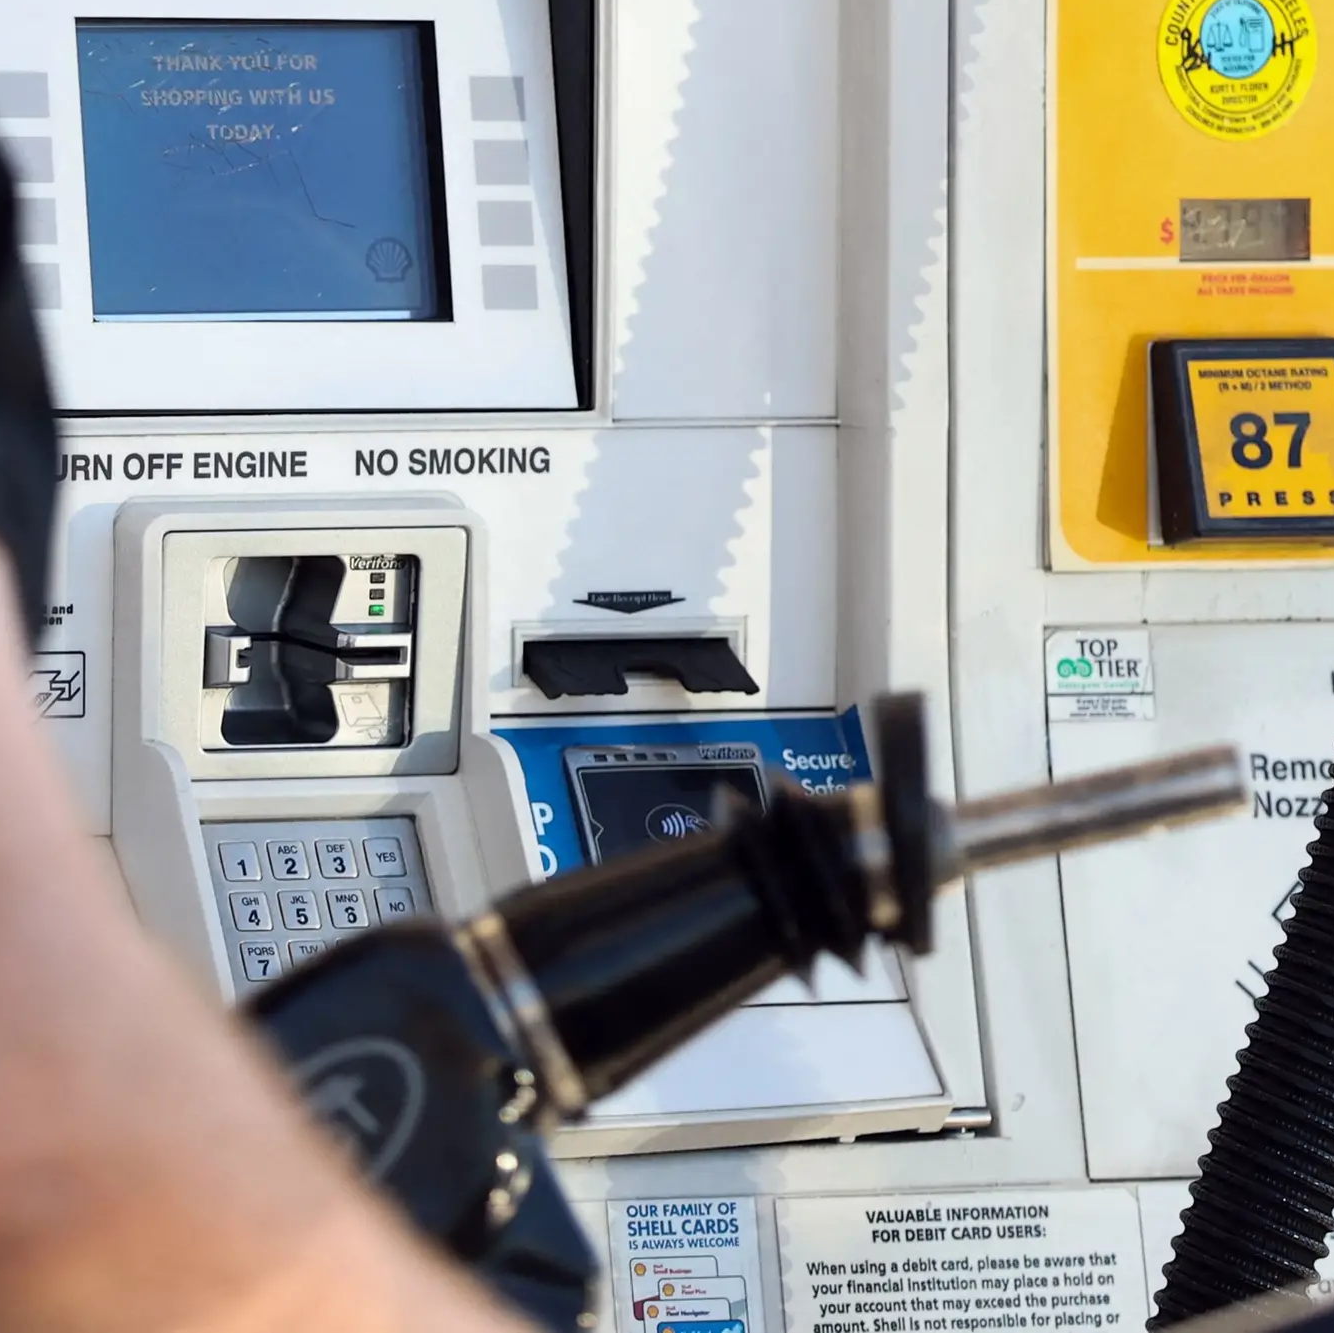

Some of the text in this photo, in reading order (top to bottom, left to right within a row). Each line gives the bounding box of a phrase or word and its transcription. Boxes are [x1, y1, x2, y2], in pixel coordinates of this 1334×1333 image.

[153, 54, 223, 72] THANK
[228, 54, 270, 72] YOU
[141, 89, 336, 107] SHOPPING WITH US
[1160, 217, 1175, 246] $
[1246, 369, 1288, 379] OCTANE
[1268, 381, 1312, 391] METHOD
[1229, 411, 1312, 469] 87
[56, 447, 551, 482] URN OFF ENGINE NO SMOKING
[1075, 638, 1119, 658] TOP
[1253, 790, 1324, 819] Nozz
[277, 845, 298, 855] ABC
[326, 844, 346, 853] DEF
[375, 852, 397, 863] YES
[237, 859, 247, 876] 1
[283, 857, 298, 875] 2
[332, 856, 346, 874] 3
[241, 896, 260, 907] GHI
[290, 895, 308, 905] JKL
[335, 894, 359, 903] MNO
[389, 901, 406, 913] NO
[248, 909, 261, 926] 4
[296, 907, 309, 925] 5
[344, 906, 358, 924] 6
[247, 946, 275, 956] PQRS
[257, 959, 270, 977] 7
[626, 1202, 737, 1219] OUR FAMILY OF
[866, 1206, 1049, 1224] VALUABLE INFORMATION
[627, 1218, 739, 1237] SHELL CARDS
[871, 1224, 1047, 1243] FOR DEBIT CARD USERS:
[629, 1236, 740, 1250] IS ALWAYS WELCOME
[806, 1252, 1117, 1277] When using a debit card, please be aware that
[812, 1272, 1115, 1299] your financial institution may place a hold on
[819, 1292, 1110, 1317] your account that may exceed the purchase
[813, 1320, 870, 1333] amount.
[873, 1317, 905, 1332] Shell
[924, 1316, 947, 1330] not
[951, 1313, 1027, 1332] responsible
[1031, 1313, 1051, 1327] for
[1054, 1312, 1102, 1328] placing
[1106, 1313, 1120, 1324] or
